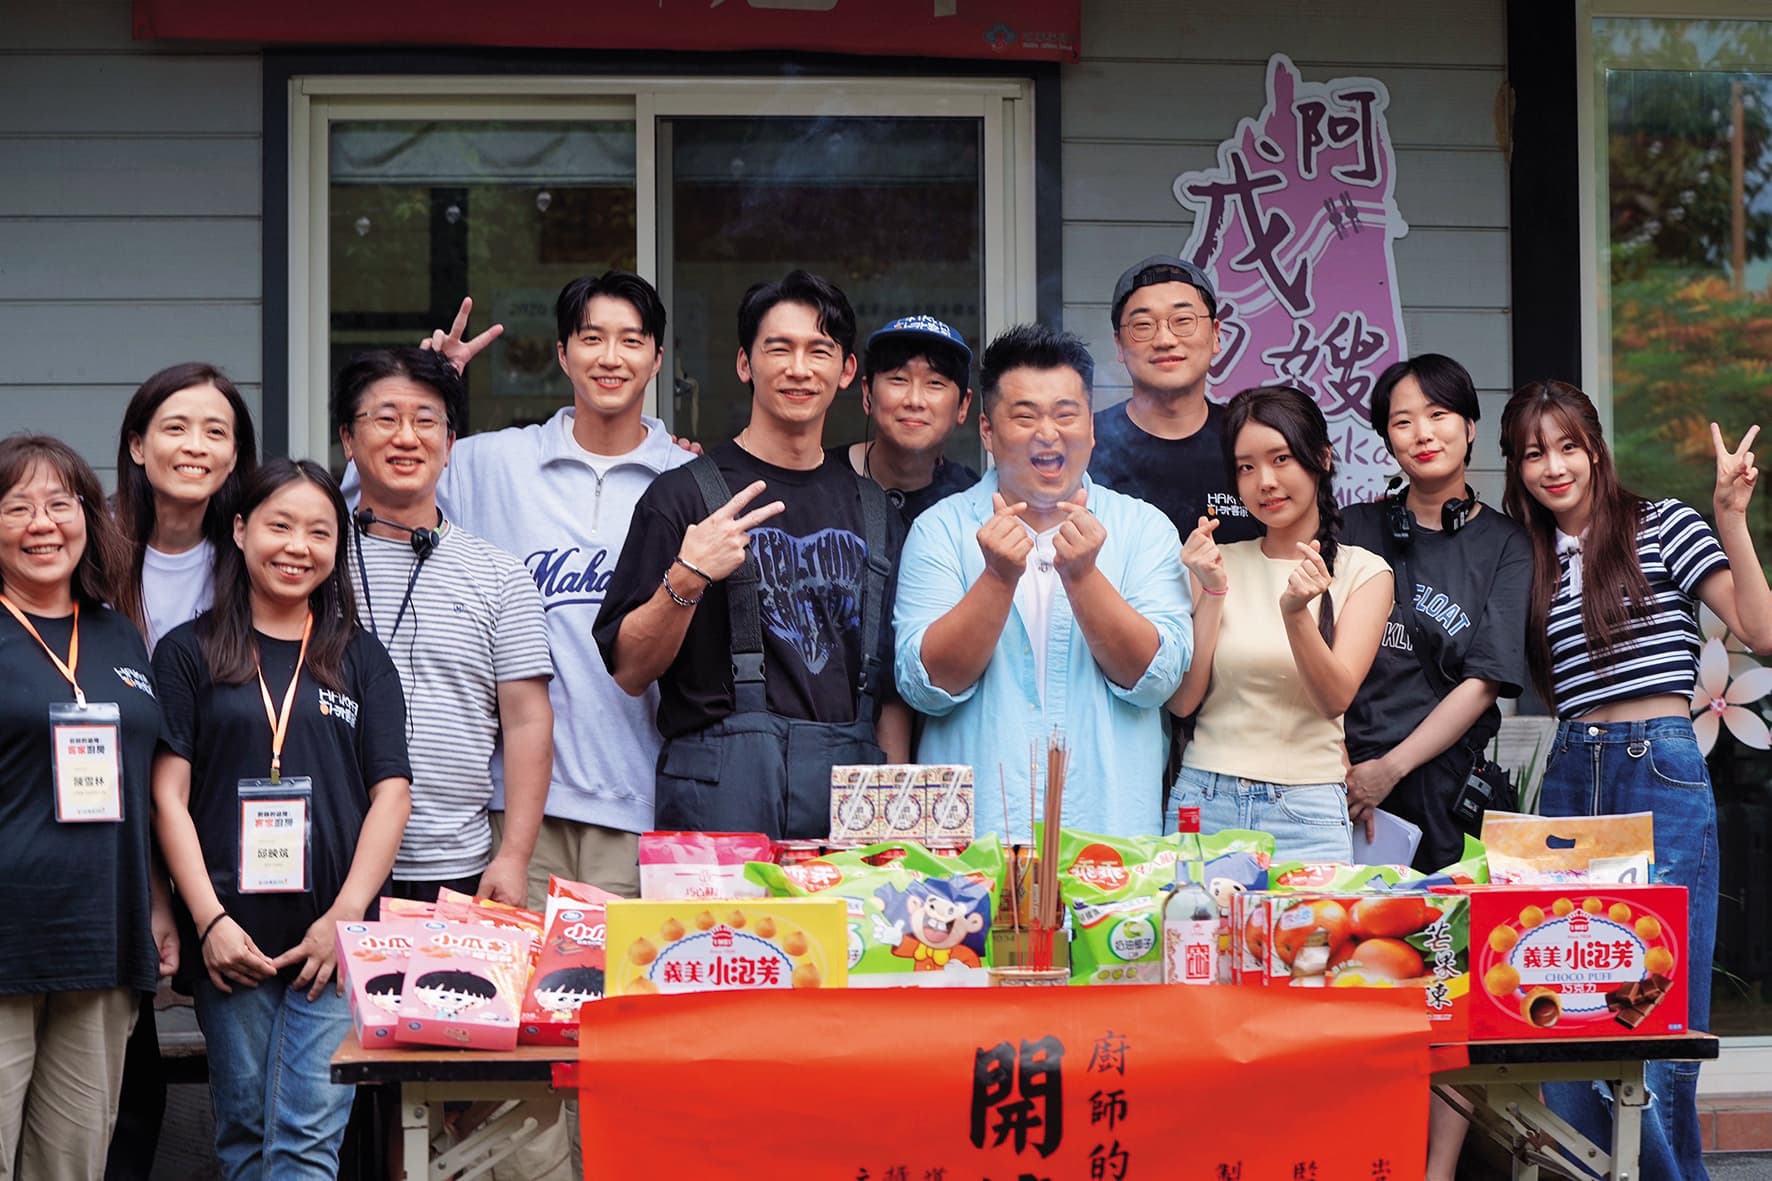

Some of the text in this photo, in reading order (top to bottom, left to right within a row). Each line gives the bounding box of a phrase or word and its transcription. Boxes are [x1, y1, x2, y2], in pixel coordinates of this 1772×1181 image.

[1545, 972, 1612, 982] CHOCO PUFF
[969, 1034, 1066, 1181] 開
